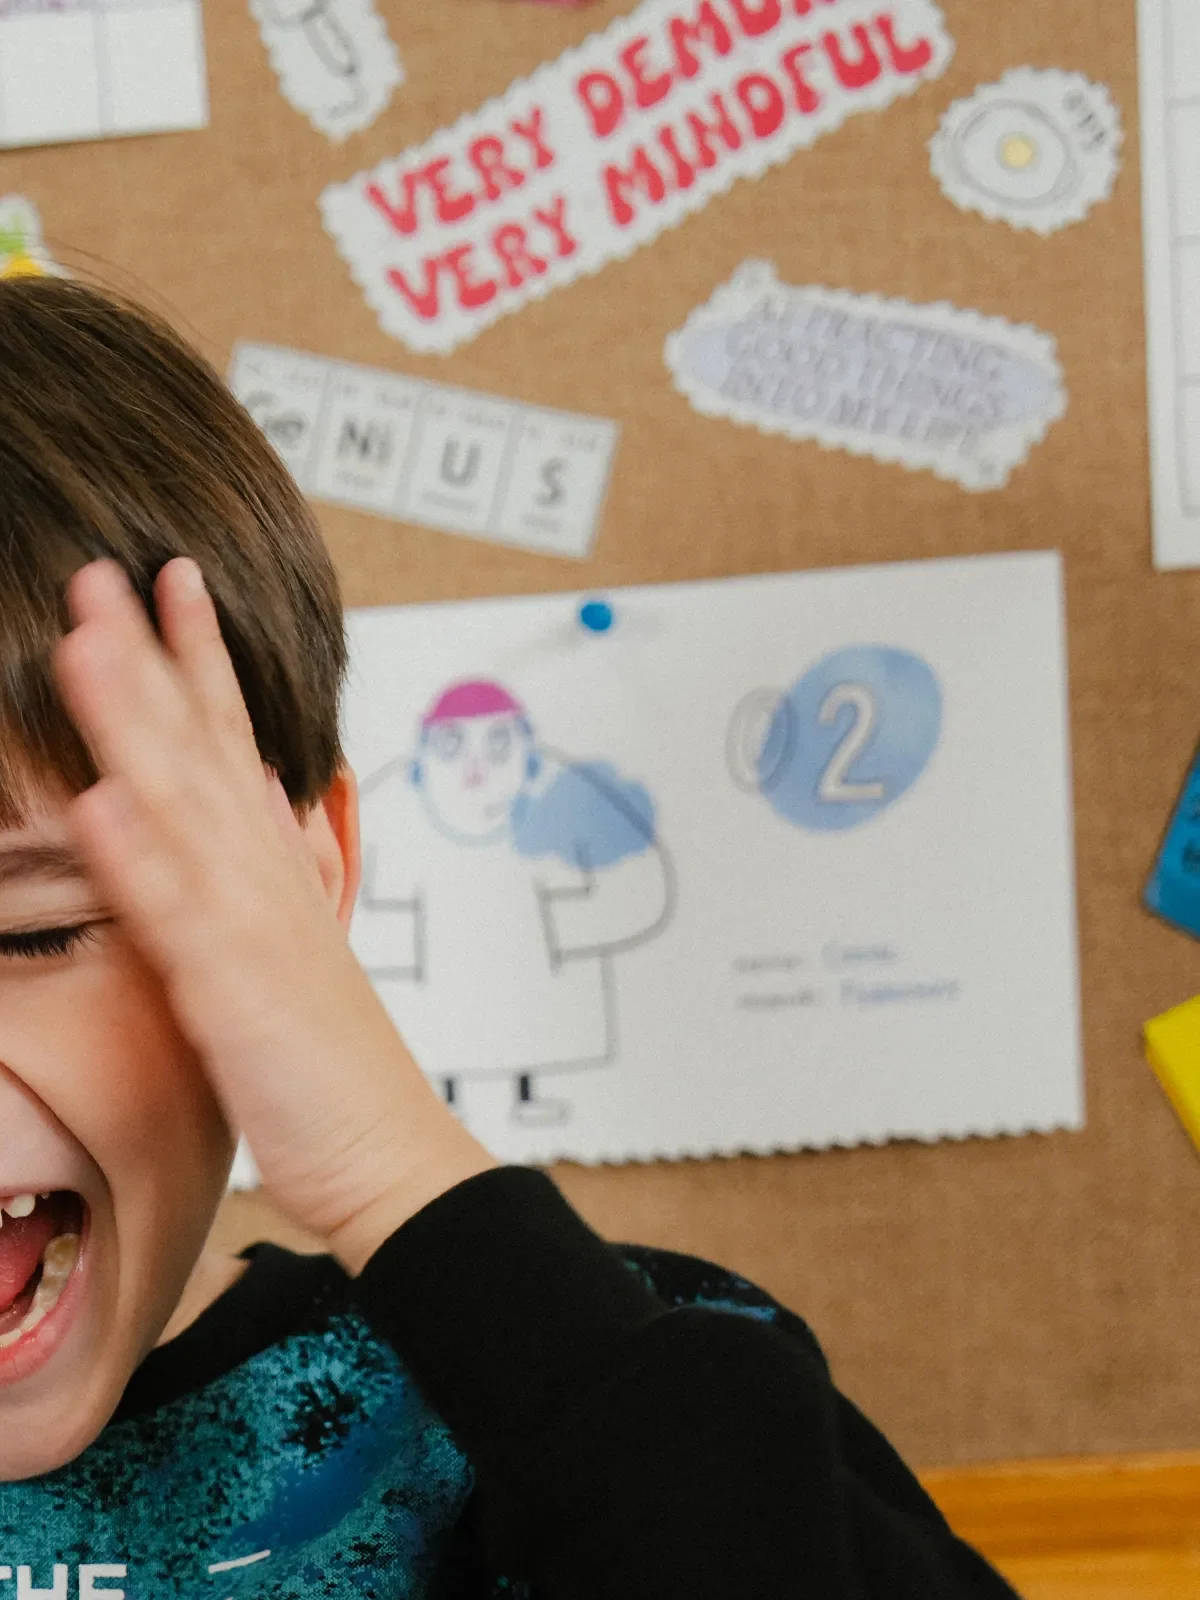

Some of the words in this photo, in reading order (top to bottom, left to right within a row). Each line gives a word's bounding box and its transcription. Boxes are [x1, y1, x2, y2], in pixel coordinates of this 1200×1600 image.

[364, 105, 556, 238] VERY
[574, 0, 837, 139] DEMU
[386, 194, 579, 322] VERY
[600, 11, 935, 229] MINDFUL
